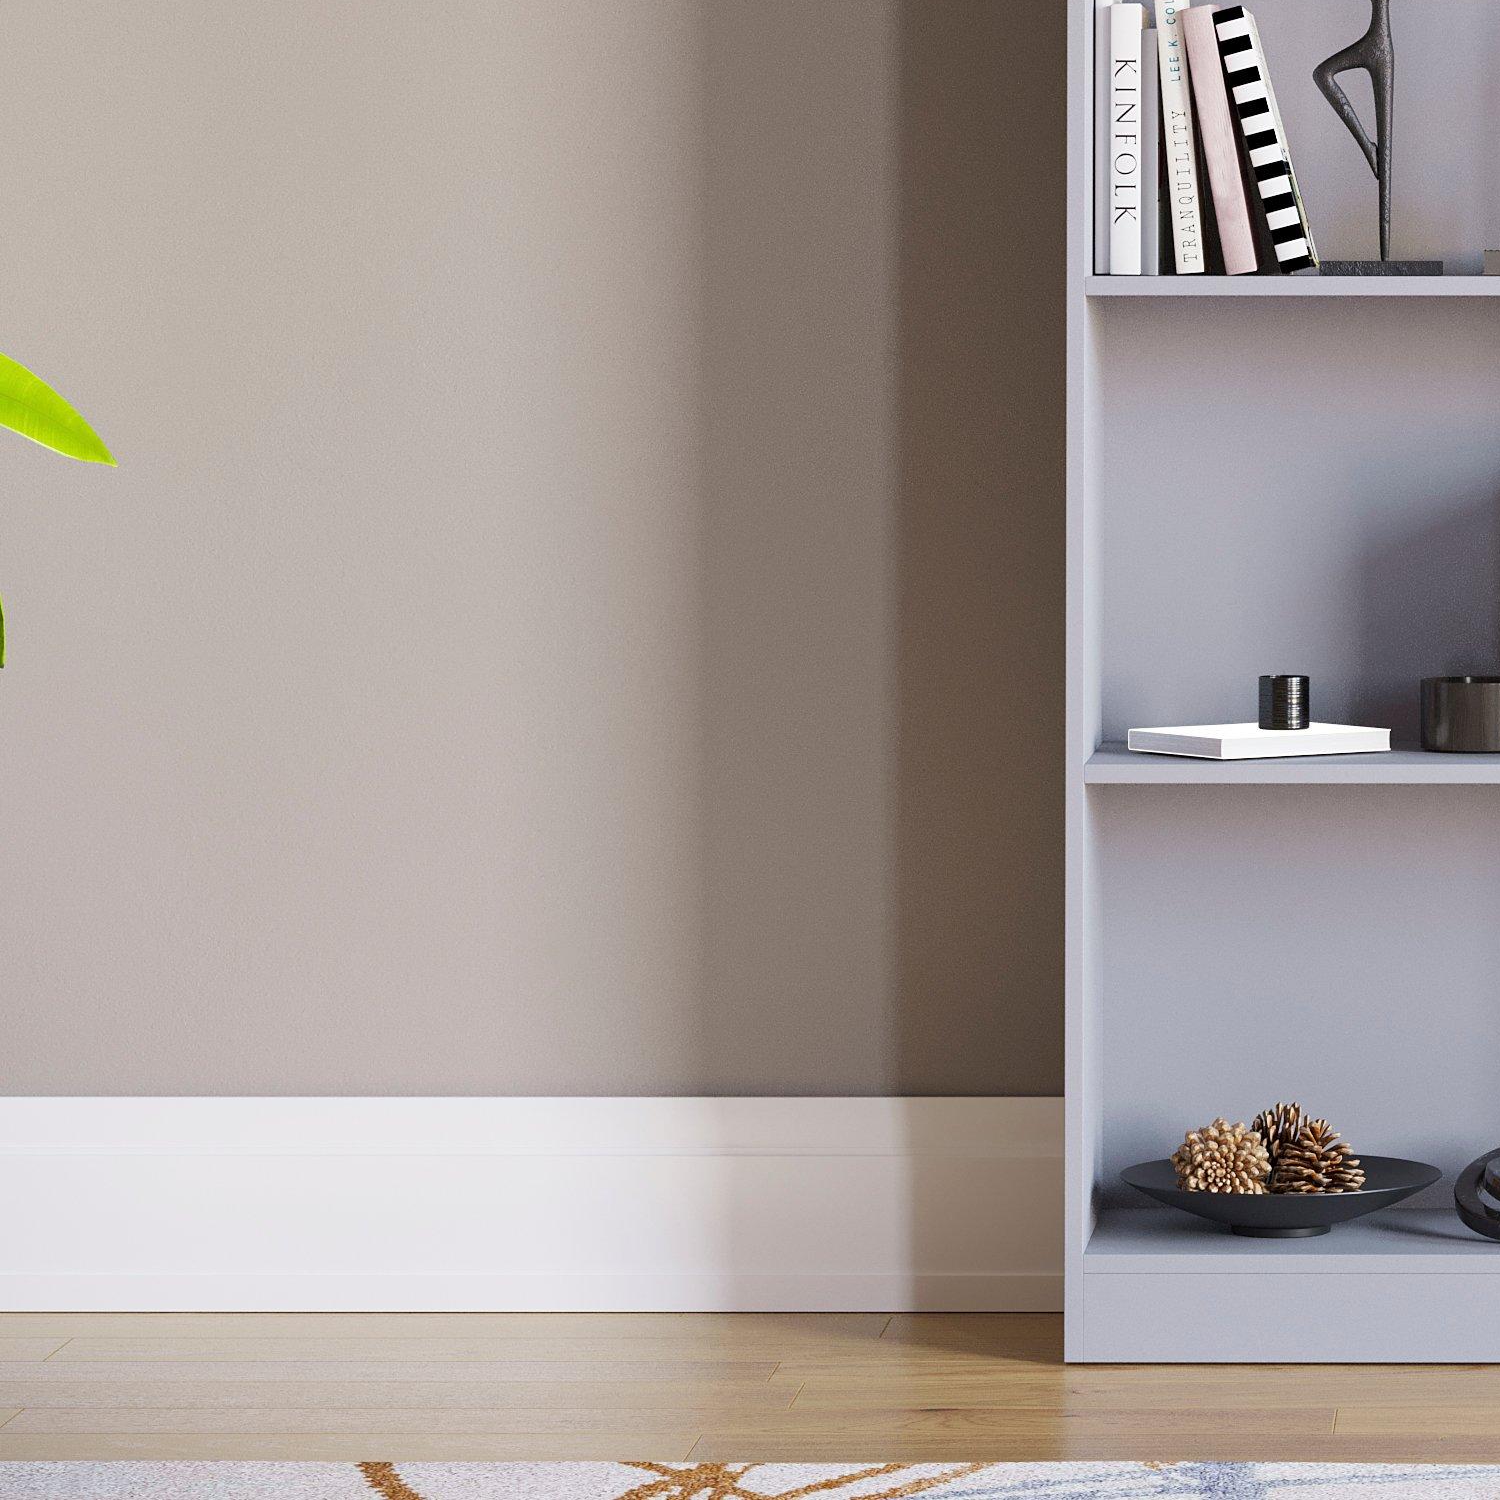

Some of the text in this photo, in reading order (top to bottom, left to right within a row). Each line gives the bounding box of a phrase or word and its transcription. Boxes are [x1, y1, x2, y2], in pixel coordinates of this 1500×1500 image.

[1168, 34, 1178, 47] K.
[1169, 56, 1181, 82] LEE
[1114, 58, 1137, 225] KINFOLK
[1171, 110, 1198, 263] TRANQUILITY
